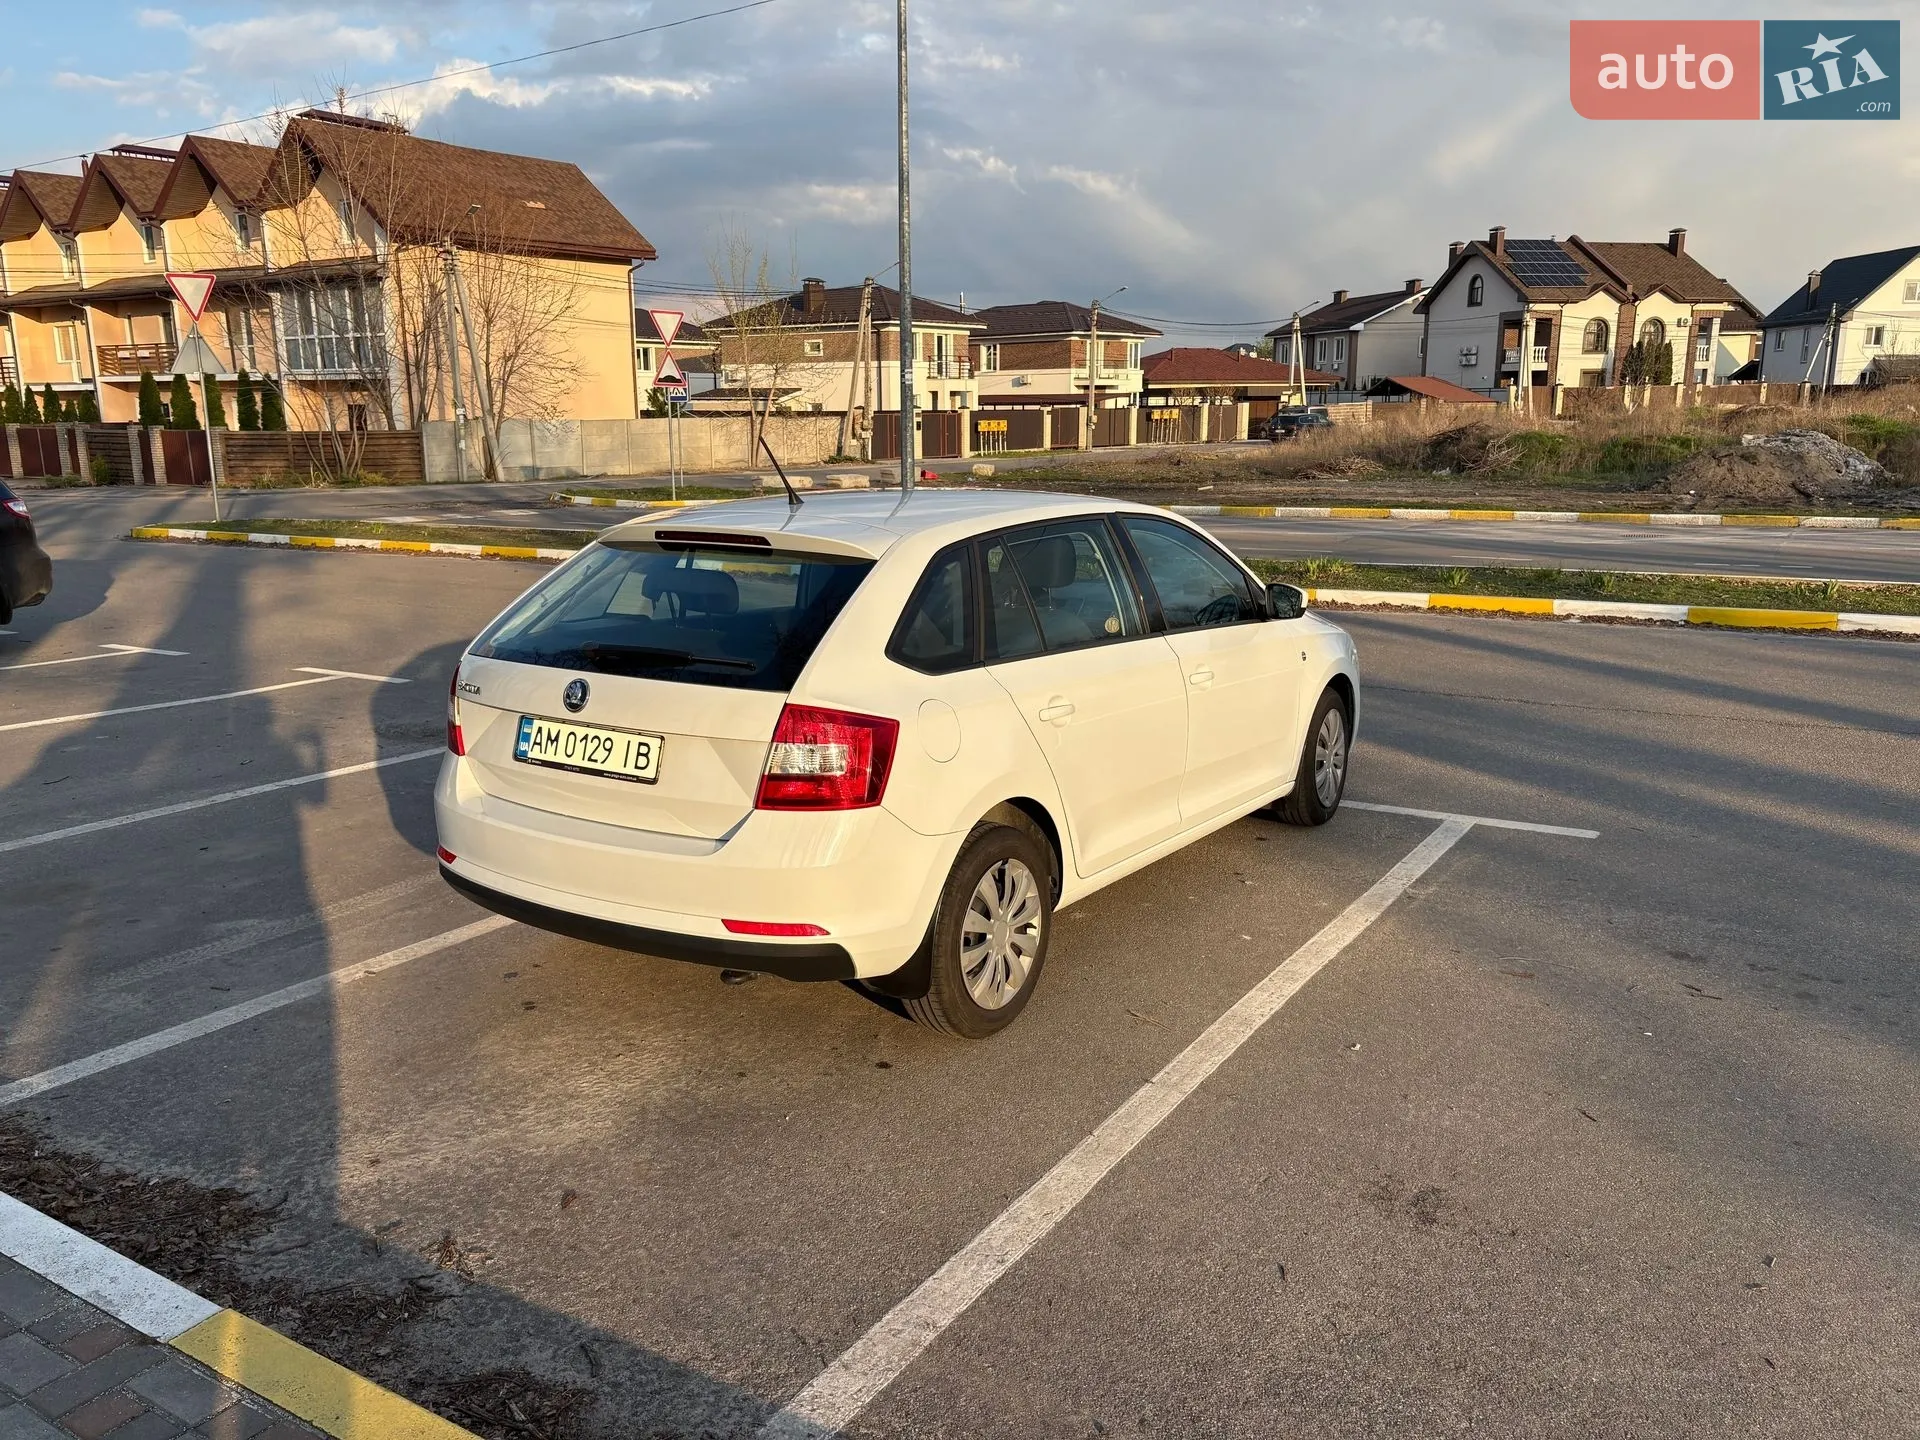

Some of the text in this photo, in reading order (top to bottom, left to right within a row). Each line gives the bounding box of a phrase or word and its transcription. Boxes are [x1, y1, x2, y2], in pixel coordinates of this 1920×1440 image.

[530, 726, 651, 771] AM 0129 IB
